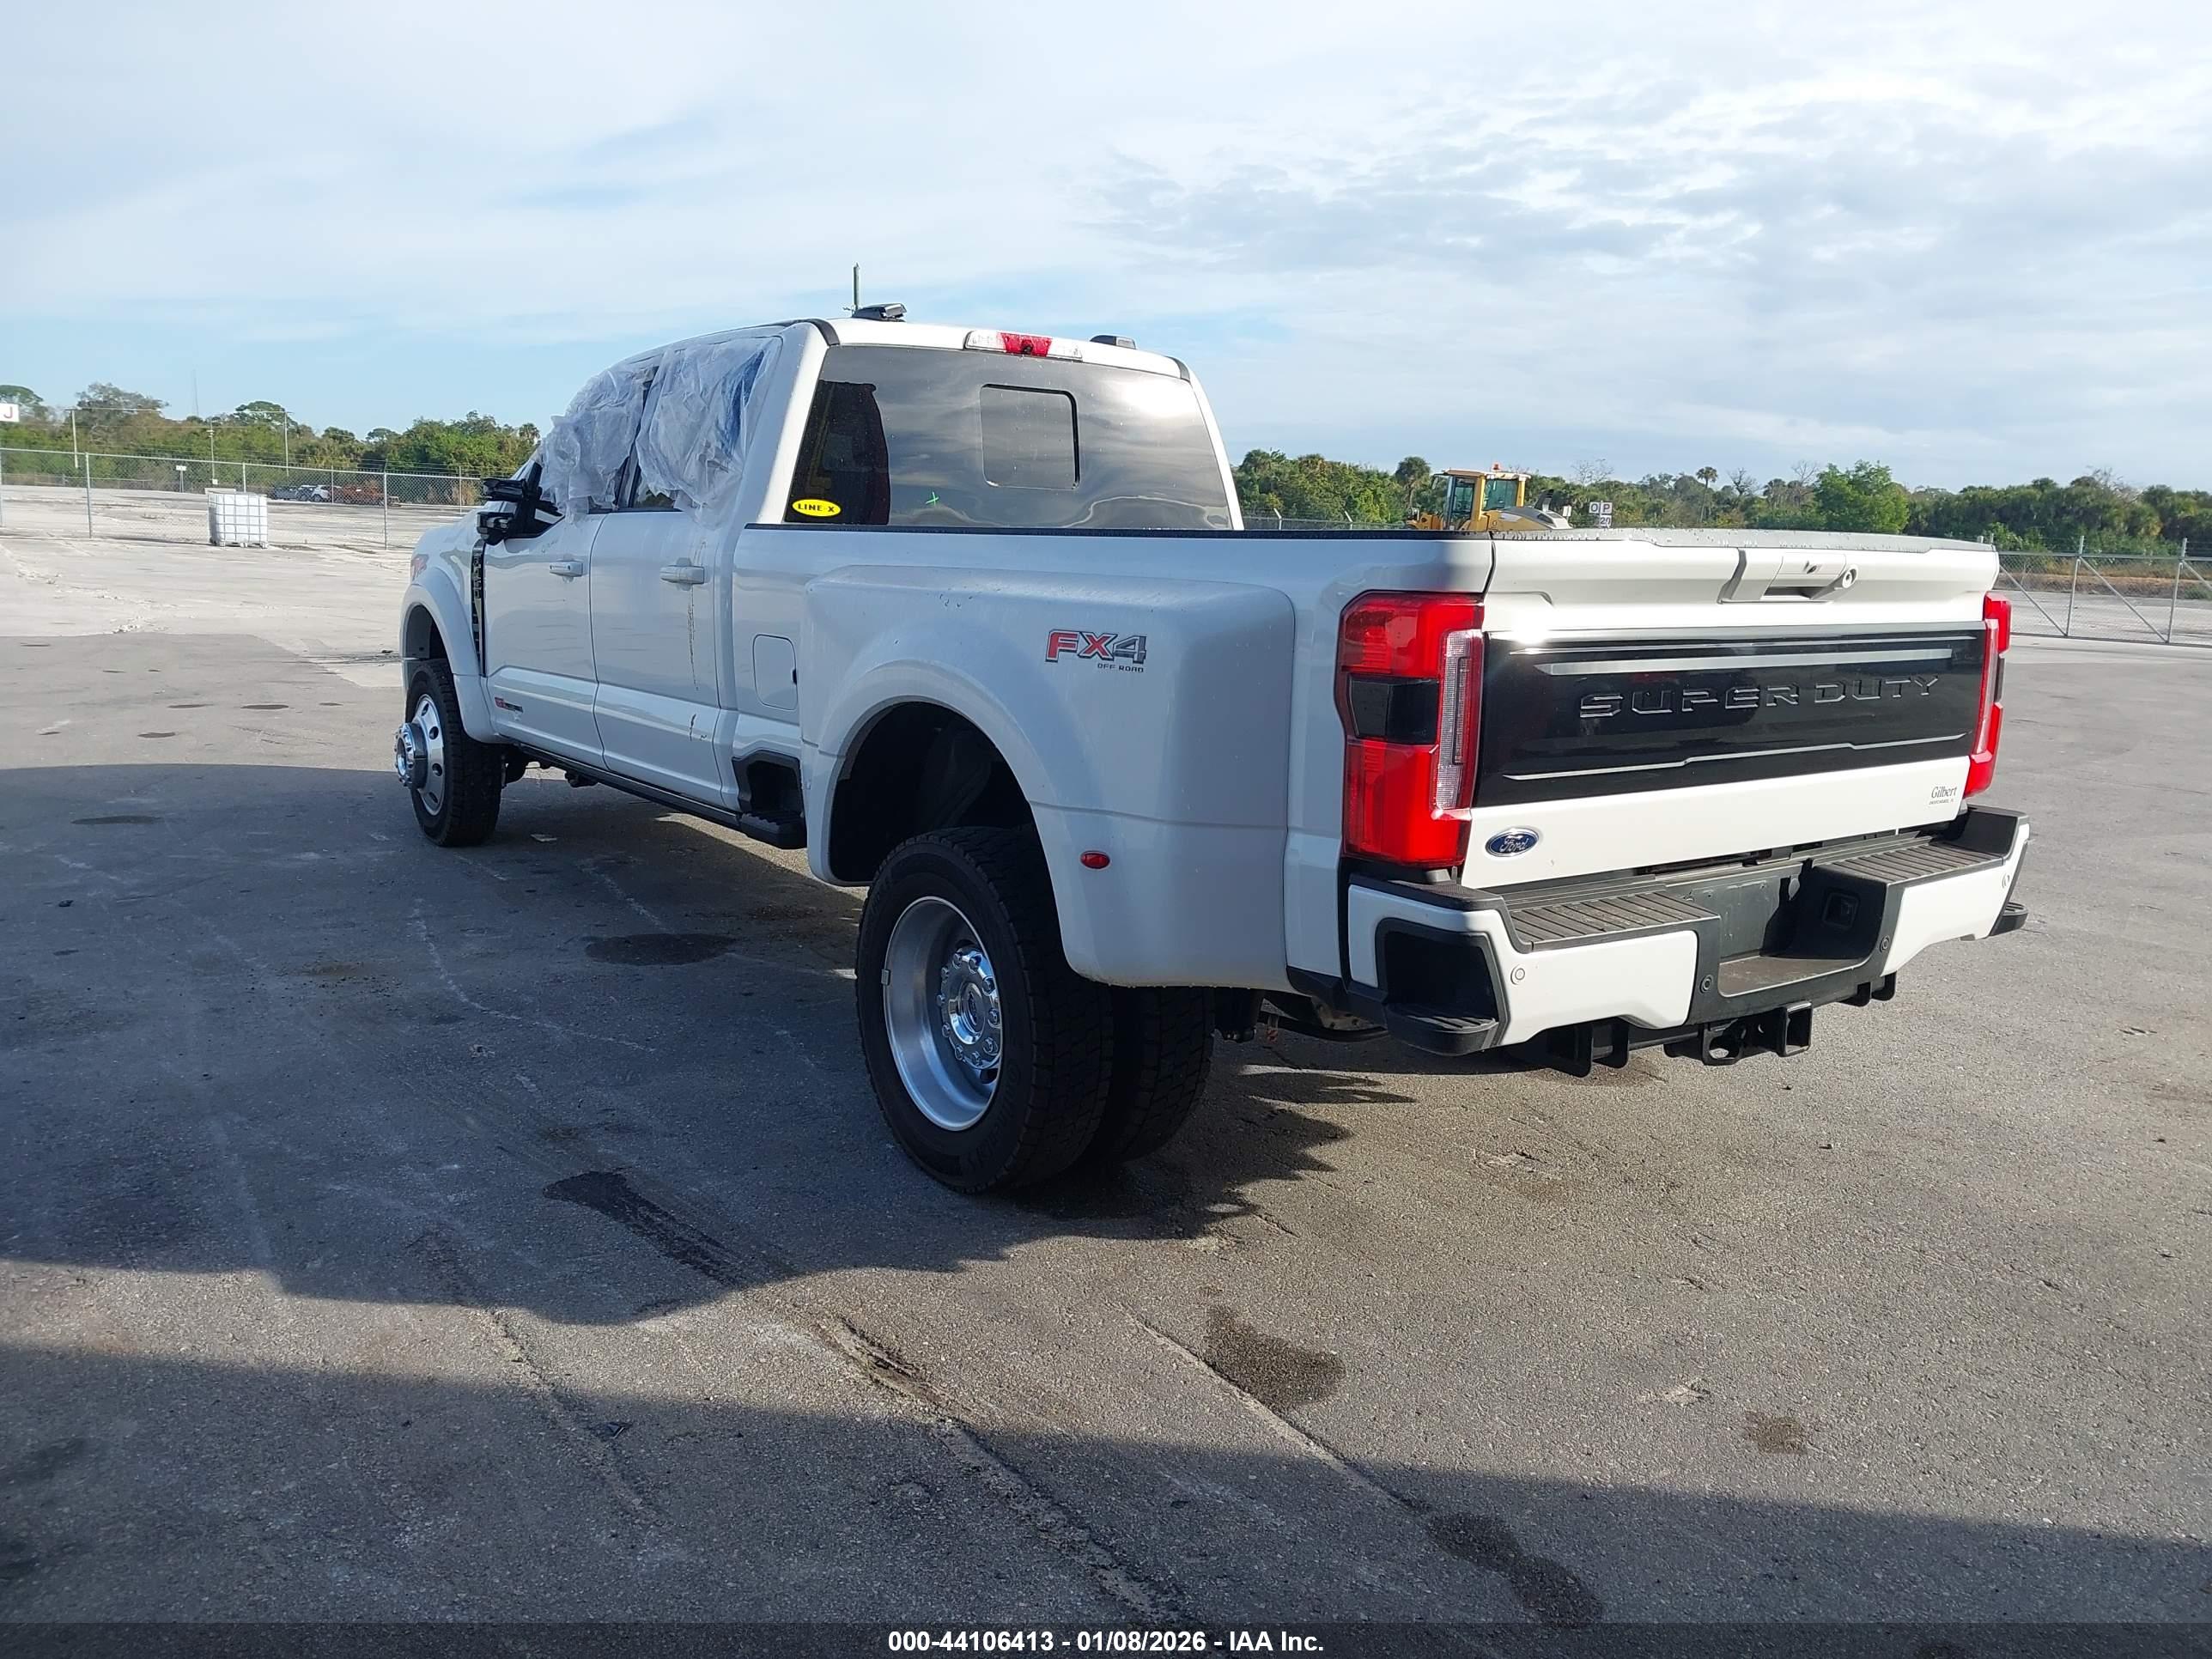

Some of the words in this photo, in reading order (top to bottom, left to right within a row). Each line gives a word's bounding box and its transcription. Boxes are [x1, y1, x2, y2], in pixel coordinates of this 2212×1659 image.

[3, 406, 13, 419] J
[1603, 503, 1611, 513] P
[1045, 629, 1147, 665] FX4
[1119, 665, 1144, 673] ROAD
[1579, 684, 1801, 720] SUPER
[1814, 672, 1940, 704] DUTY
[1931, 786, 1957, 799] Gilbert
[1499, 835, 1529, 853] Ford
